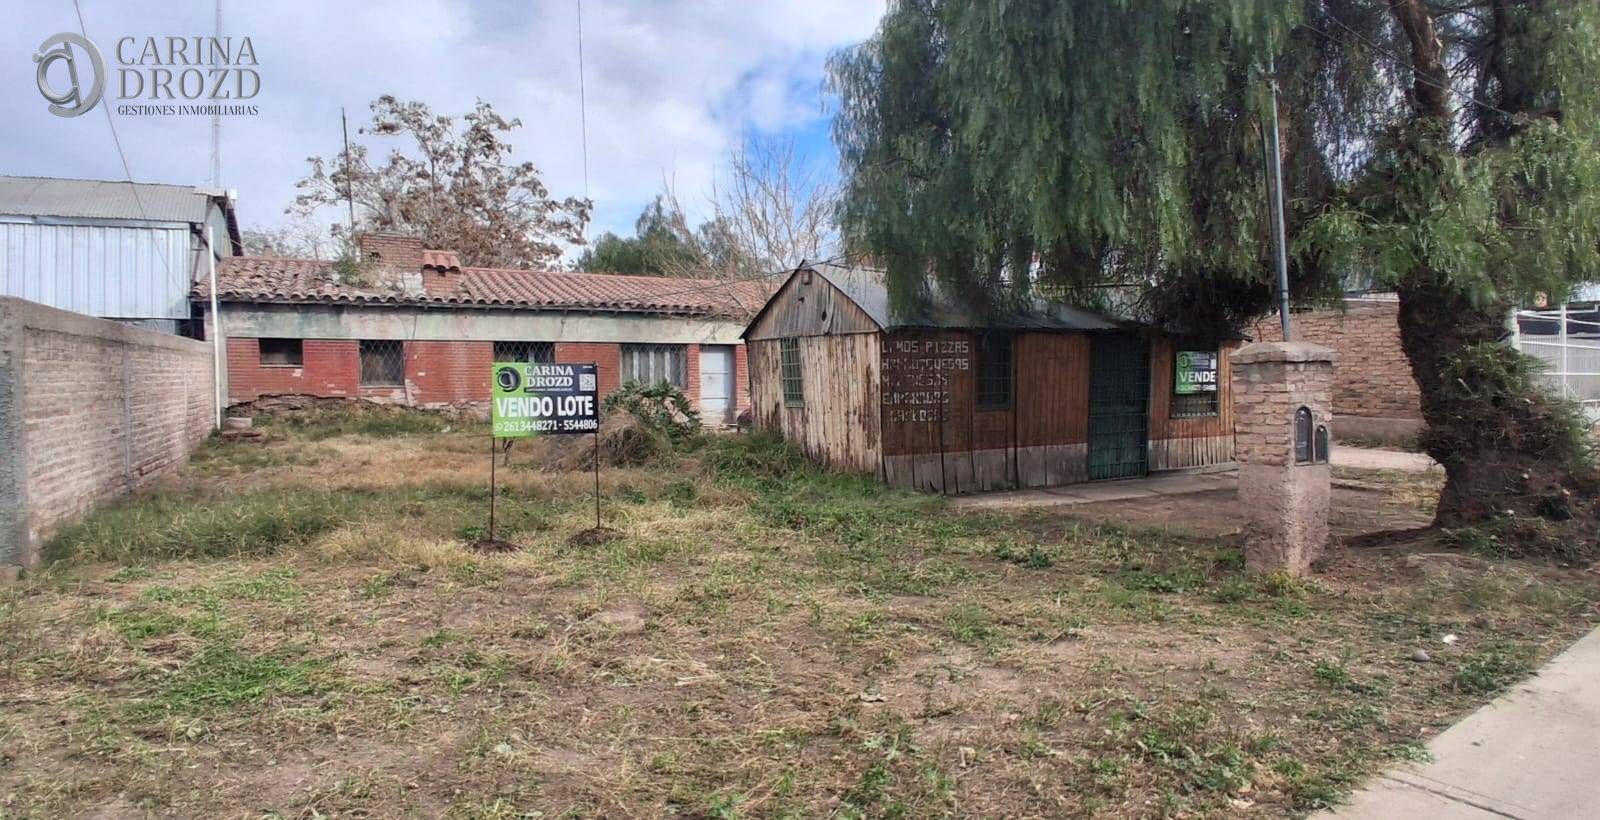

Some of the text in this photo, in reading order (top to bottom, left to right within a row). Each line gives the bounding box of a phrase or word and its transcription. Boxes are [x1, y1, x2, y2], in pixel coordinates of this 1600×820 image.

[881, 340, 969, 353] LMOS PIZZAS
[525, 365, 574, 376] CARINA
[527, 376, 573, 387] DROZD
[1178, 371, 1216, 383] VENDE
[495, 395, 594, 418] VENDO LOTE
[503, 420, 558, 432] 2613448271
[563, 419, 598, 431] 5544806
